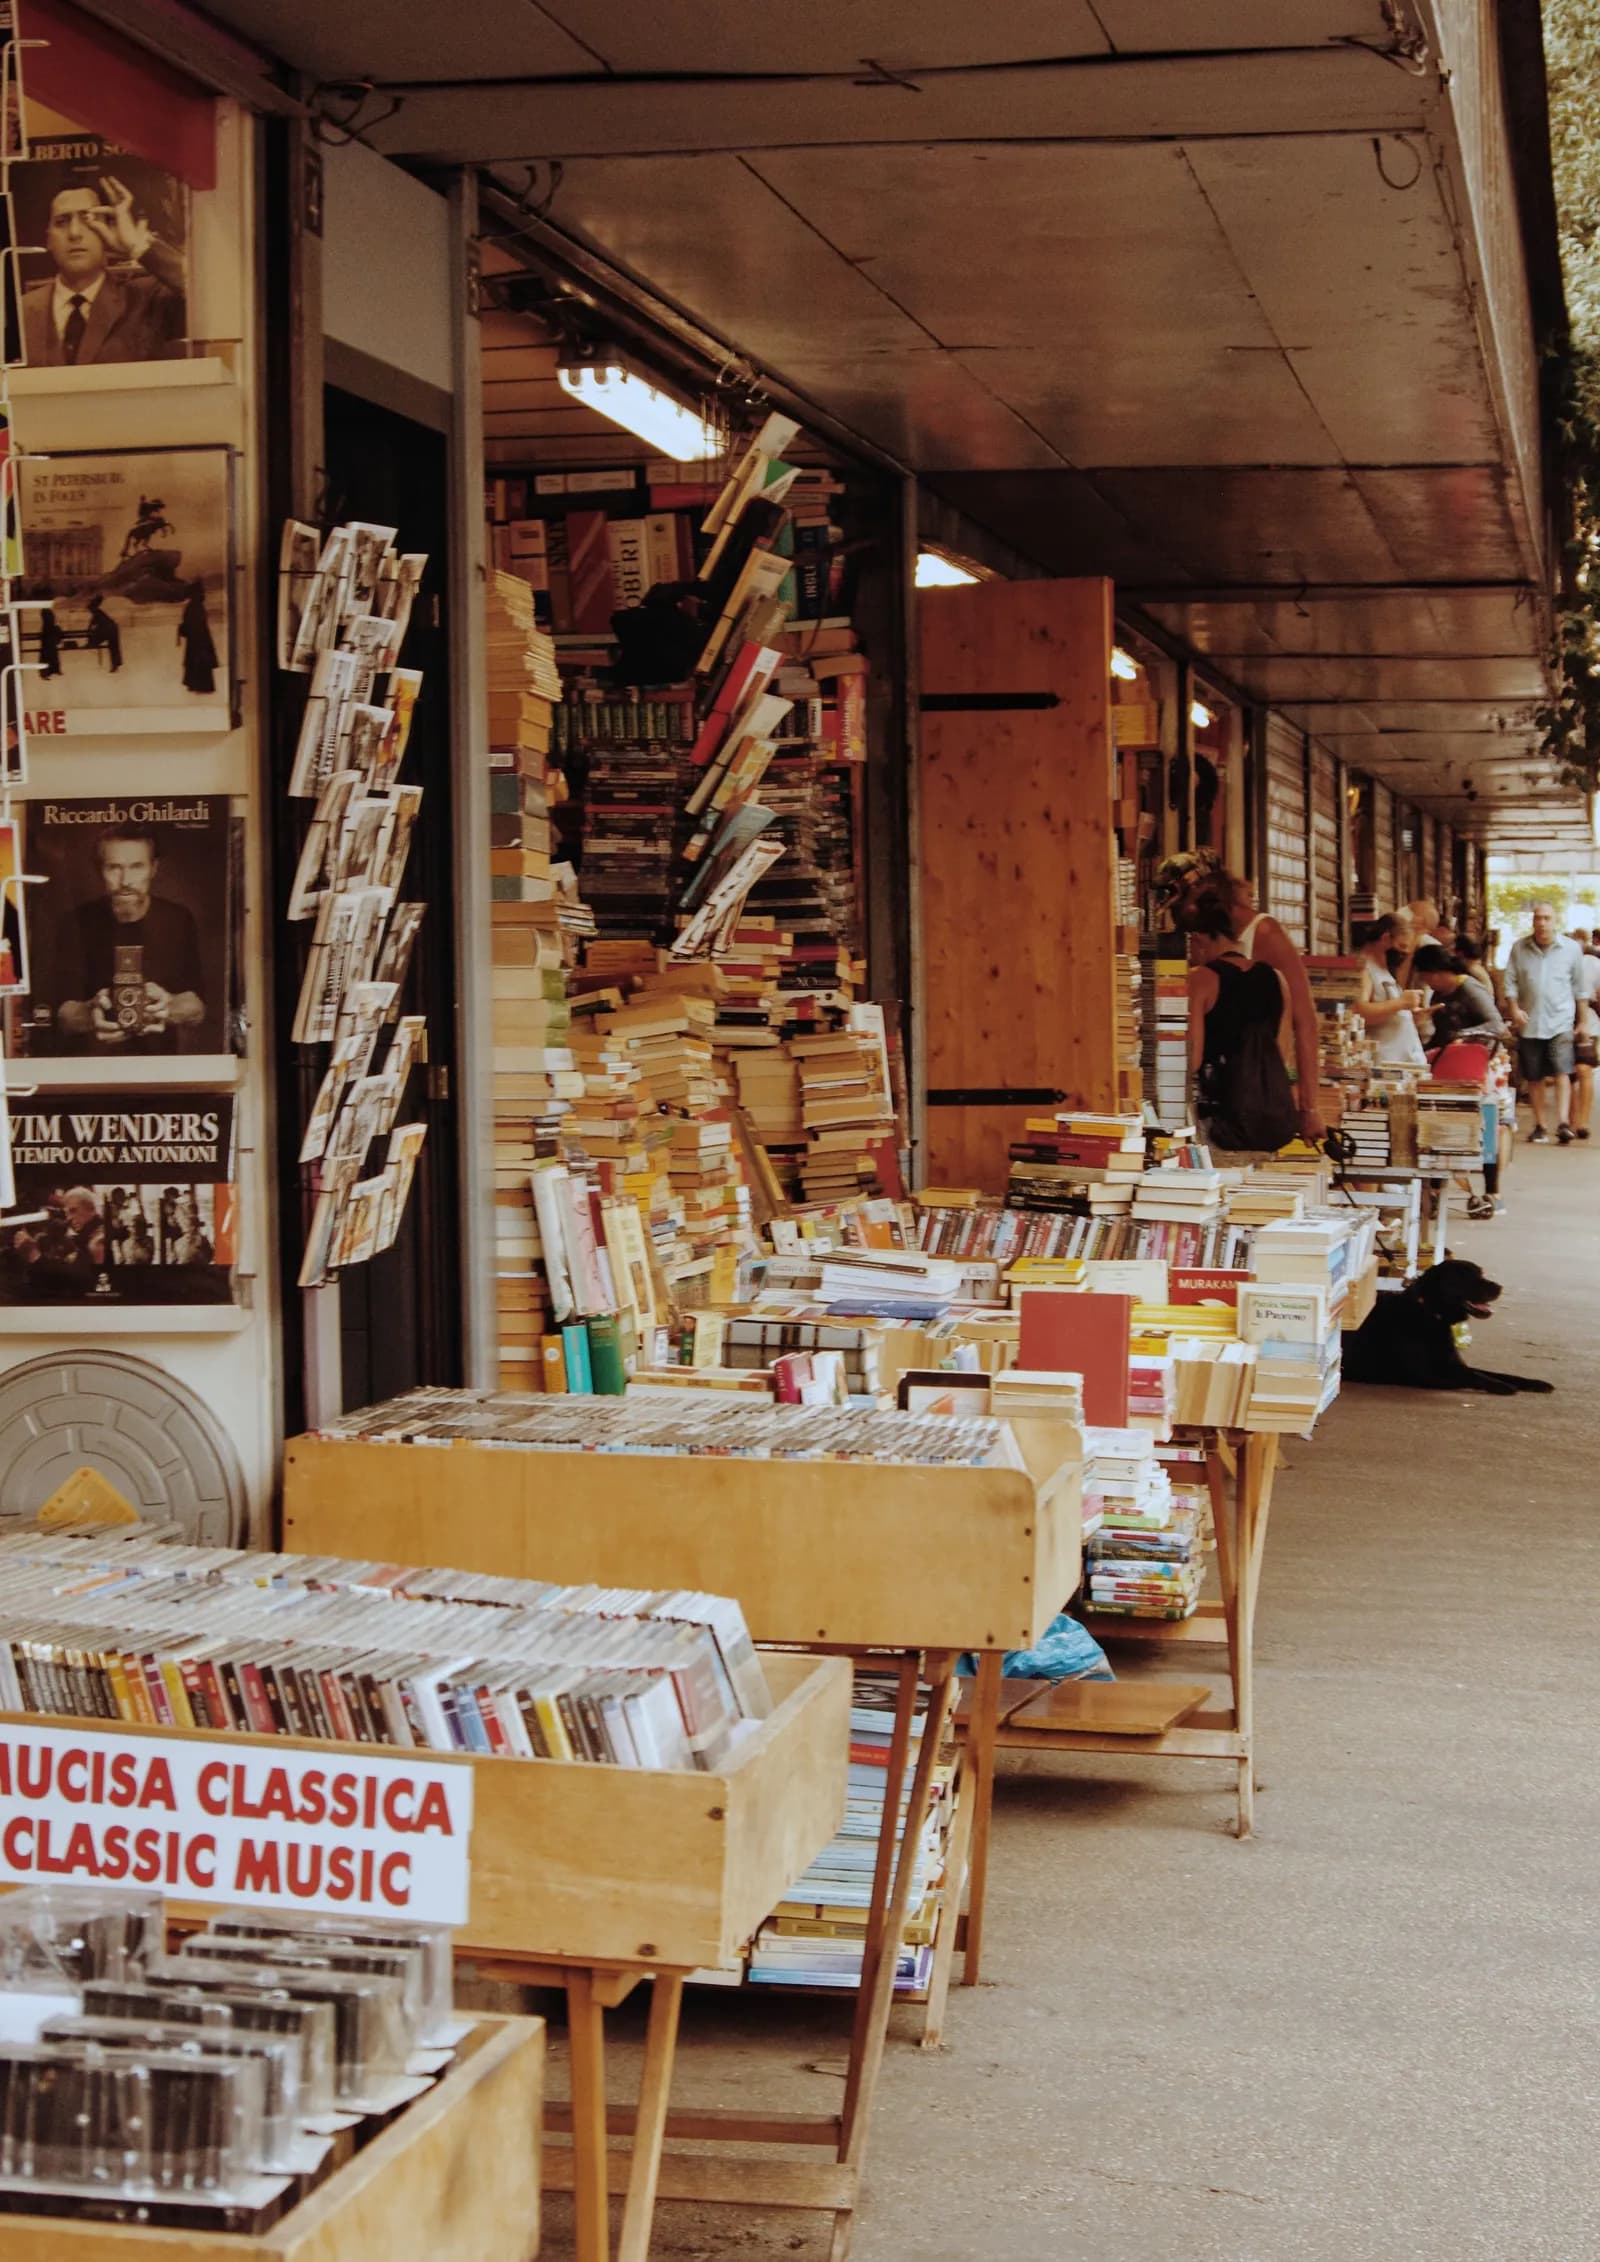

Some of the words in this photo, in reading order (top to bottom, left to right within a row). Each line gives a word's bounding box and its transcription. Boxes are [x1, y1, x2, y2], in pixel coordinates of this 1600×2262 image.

[29, 142, 98, 160] BERTO
[24, 710, 66, 735] ARE
[44, 803, 128, 825] Riccardo
[129, 801, 209, 822] Ghilardi
[69, 1113, 219, 1143] WENDERS
[12, 1146, 74, 1164] TEMPO
[77, 1146, 115, 1163] CON
[118, 1145, 218, 1163] ANTONIONI
[0, 1742, 177, 1811] UCISA
[197, 1761, 454, 1836] CLASSICA
[3, 1816, 217, 1888] CLASSIC
[234, 1838, 412, 1906] MUSIC
